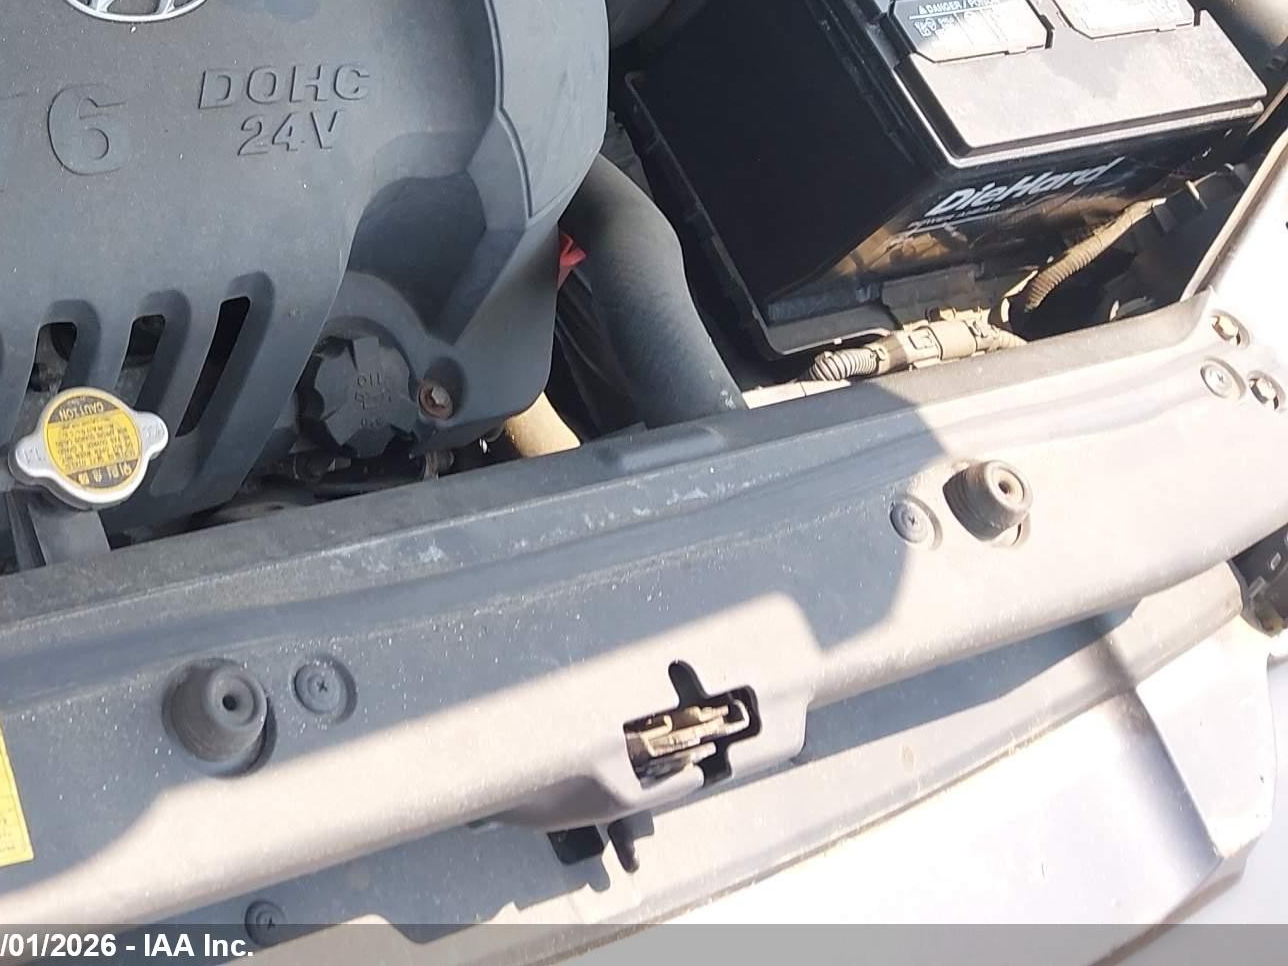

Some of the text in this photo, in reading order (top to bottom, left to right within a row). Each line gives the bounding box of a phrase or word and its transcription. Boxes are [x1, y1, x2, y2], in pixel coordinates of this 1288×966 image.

[926, 0, 962, 14] DANGER
[199, 63, 370, 111] DOHC
[238, 108, 346, 158] 24V
[925, 156, 1126, 218] DieHard
[356, 372, 382, 388] OIL
[59, 401, 104, 422] CAUTION
